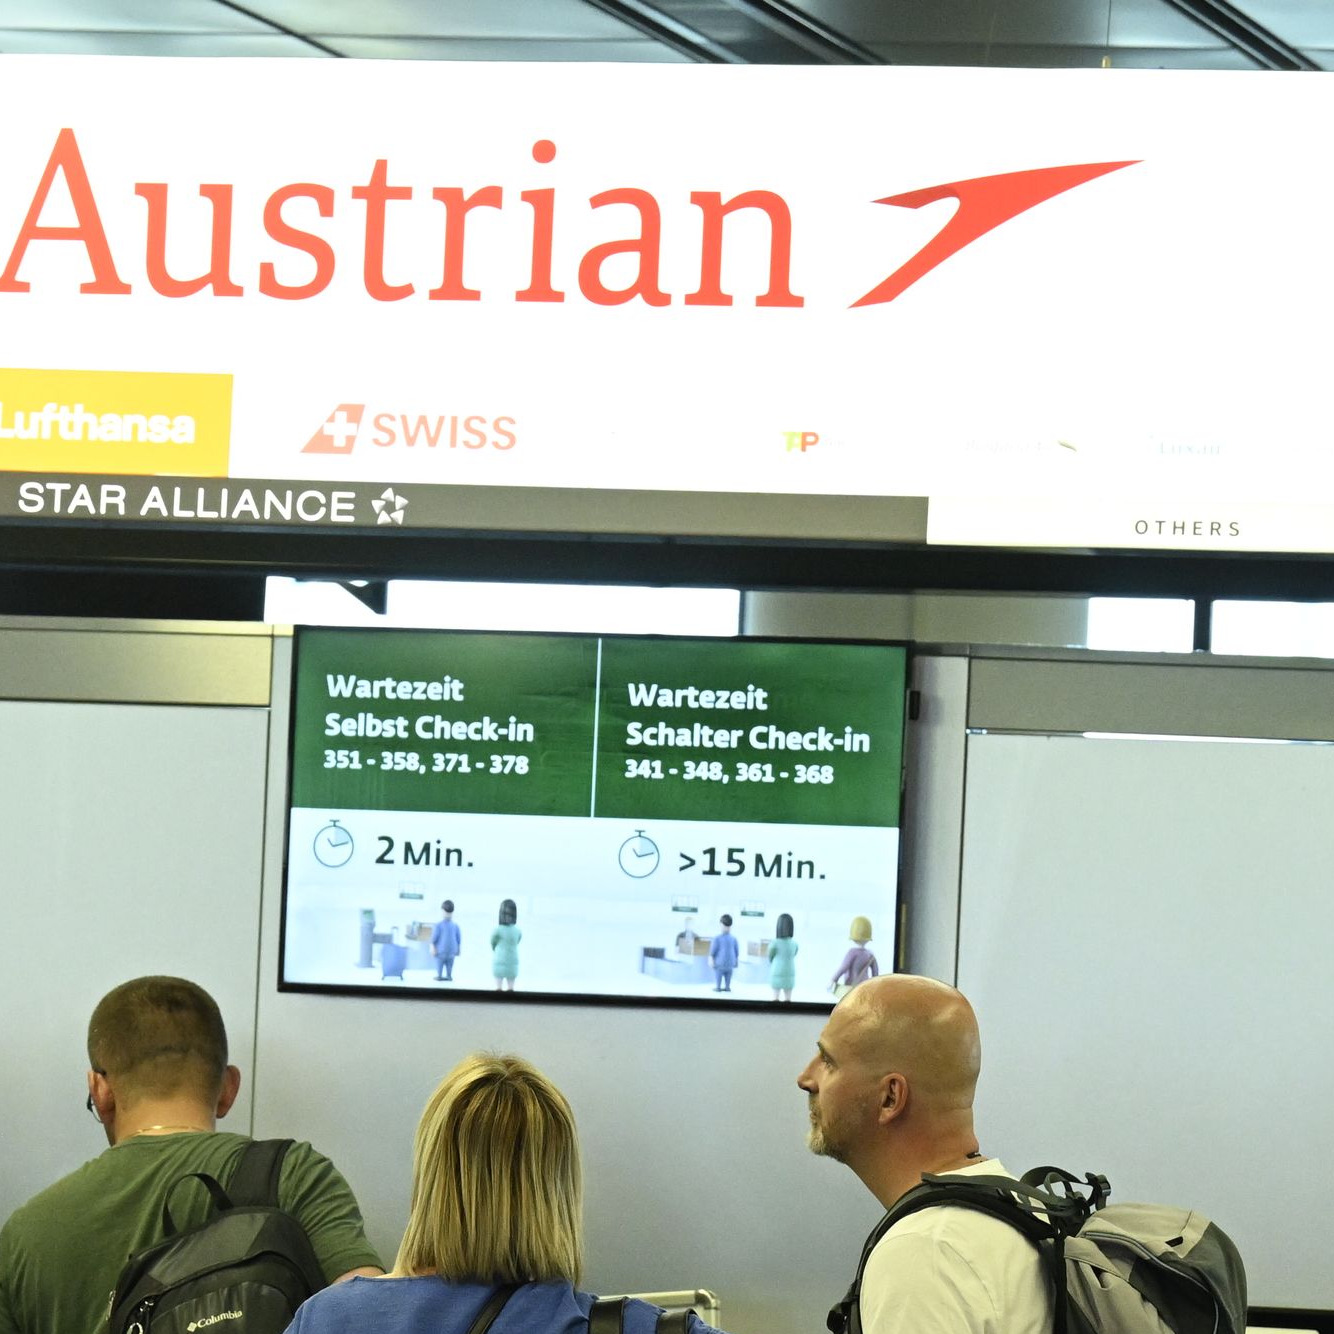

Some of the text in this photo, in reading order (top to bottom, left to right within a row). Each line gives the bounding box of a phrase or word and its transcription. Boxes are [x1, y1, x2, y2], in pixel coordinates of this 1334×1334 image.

[372, 413, 517, 450] SWISS
[18, 482, 355, 523] STAR ALLIANCE
[1135, 520, 1240, 537] OTHERS
[326, 674, 465, 702] Wartezeit
[627, 683, 768, 711] Wartezeit
[324, 712, 535, 742] Selbst Check-in
[625, 721, 870, 753] Schalter Check-in
[323, 749, 363, 771] 351
[380, 751, 426, 775] 358,
[431, 753, 472, 773] 371
[489, 754, 530, 775] 378
[624, 758, 665, 780] 341
[682, 760, 729, 784] 348,
[735, 762, 776, 783] 361
[793, 764, 835, 785] 368
[376, 836, 473, 868] 2 Min.
[679, 848, 826, 880] >15 Min.
[197, 1310, 243, 1328] Columbia
